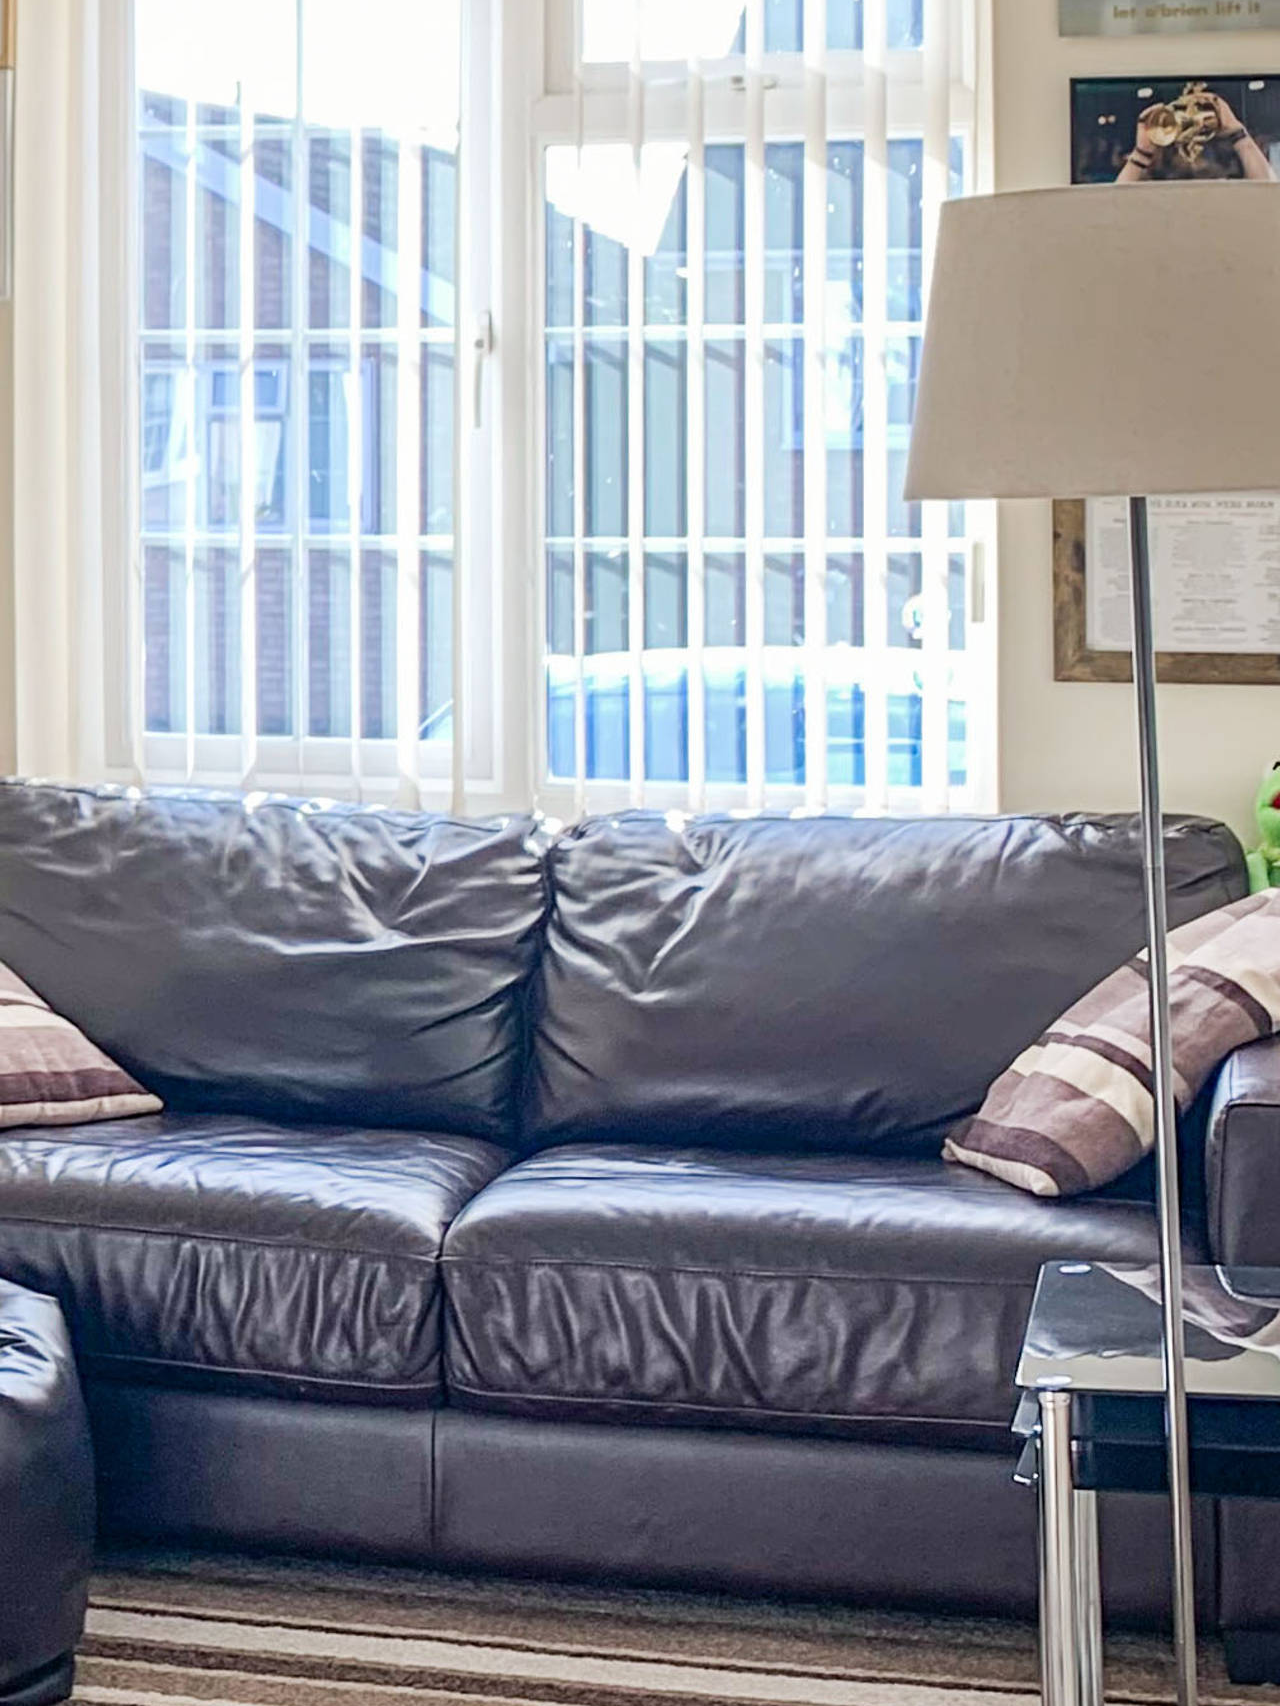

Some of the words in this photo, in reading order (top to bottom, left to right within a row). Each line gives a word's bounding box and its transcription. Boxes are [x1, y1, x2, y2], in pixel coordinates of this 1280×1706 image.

[1113, 5, 1137, 19] let
[1215, 2, 1241, 15] lift
[1248, 1, 1260, 14] it
